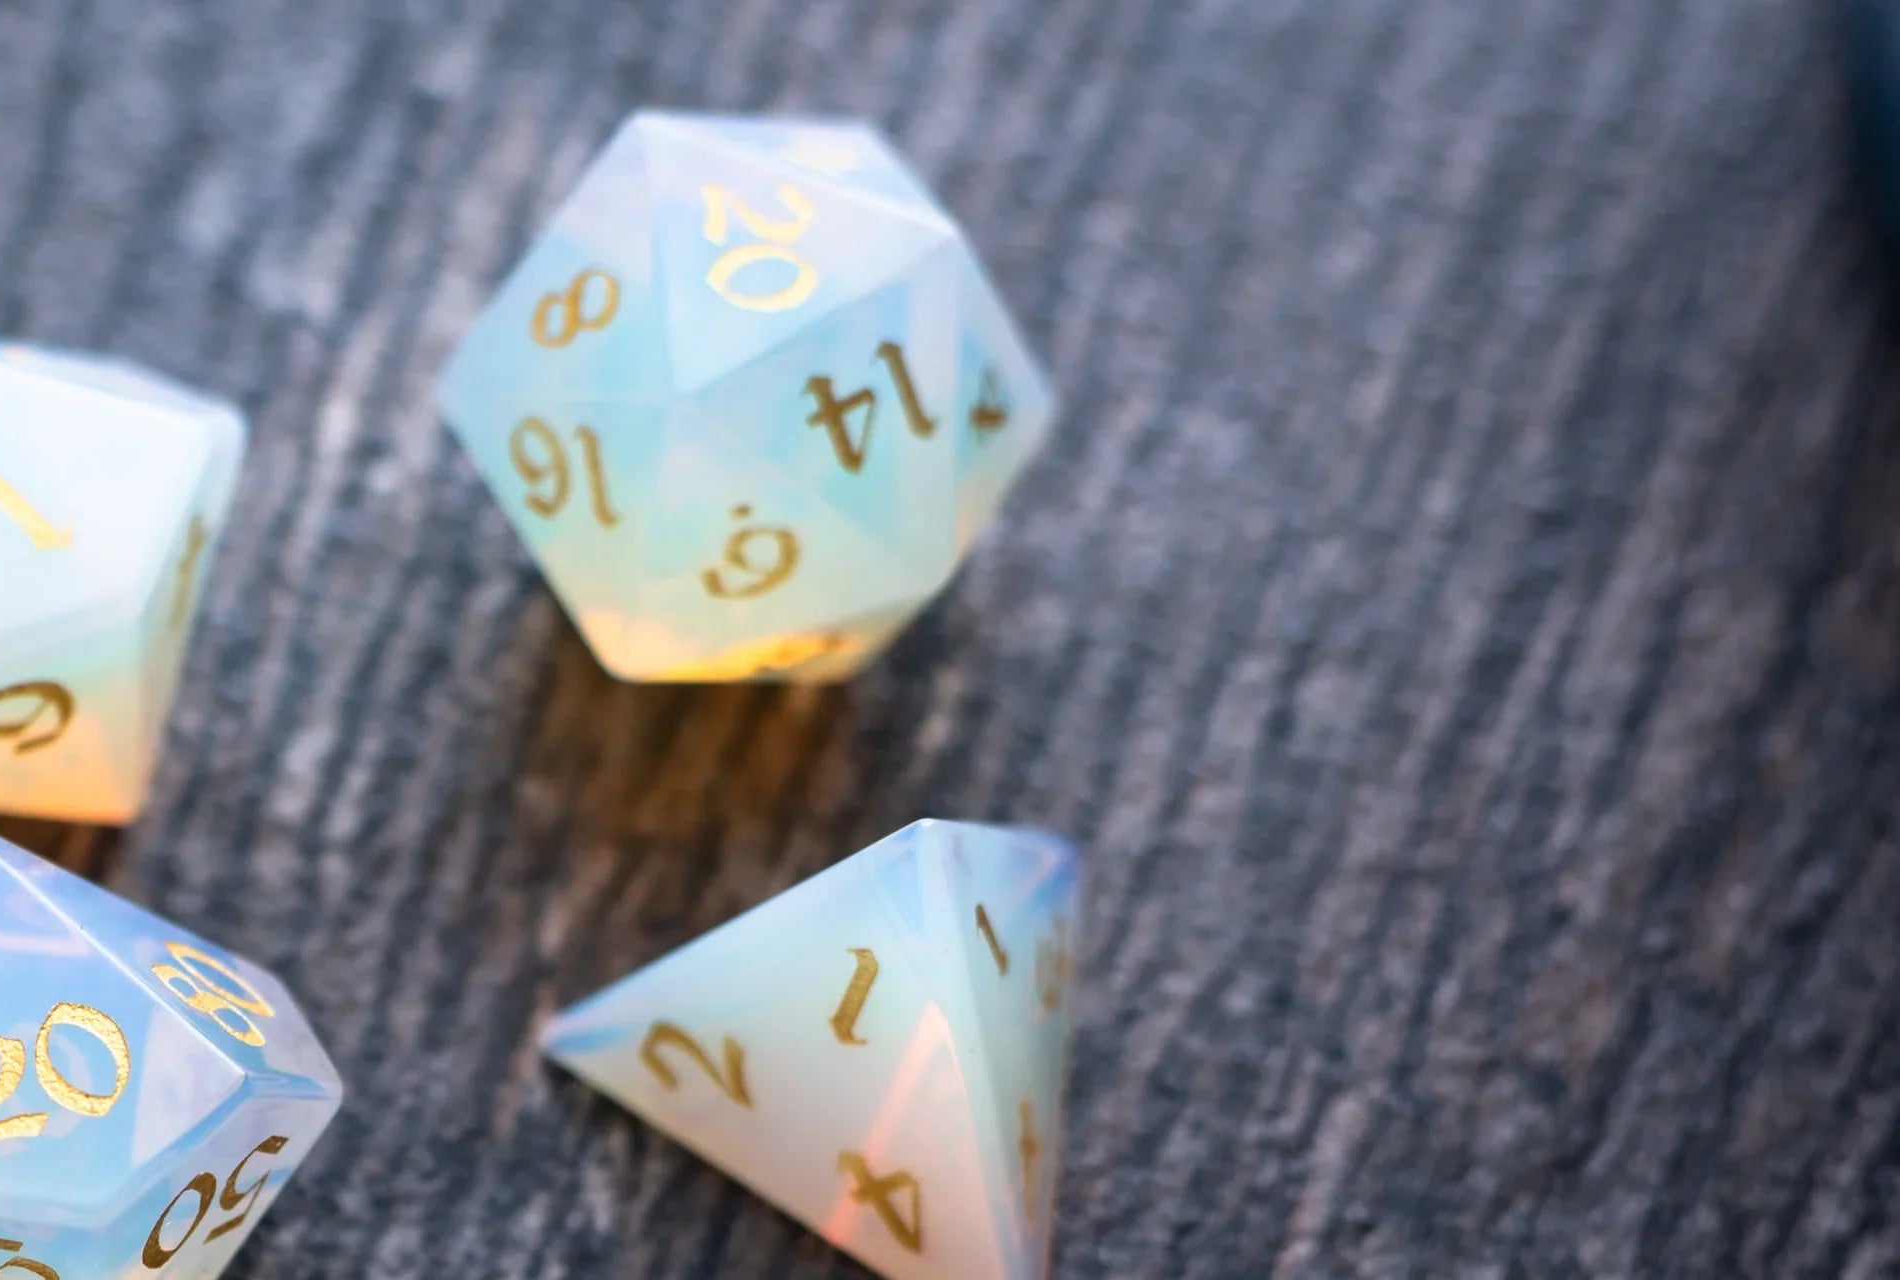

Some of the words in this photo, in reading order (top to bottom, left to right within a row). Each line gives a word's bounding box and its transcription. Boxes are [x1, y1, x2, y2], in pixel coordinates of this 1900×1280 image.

[702, 184, 818, 312] 20
[530, 268, 621, 349] 8
[802, 341, 938, 474] 14
[509, 416, 620, 528] 16
[150, 942, 275, 1047] 80
[829, 948, 879, 1046] 1
[639, 1020, 754, 1111] 2
[142, 1134, 289, 1270] 50
[837, 1149, 922, 1254] 4
